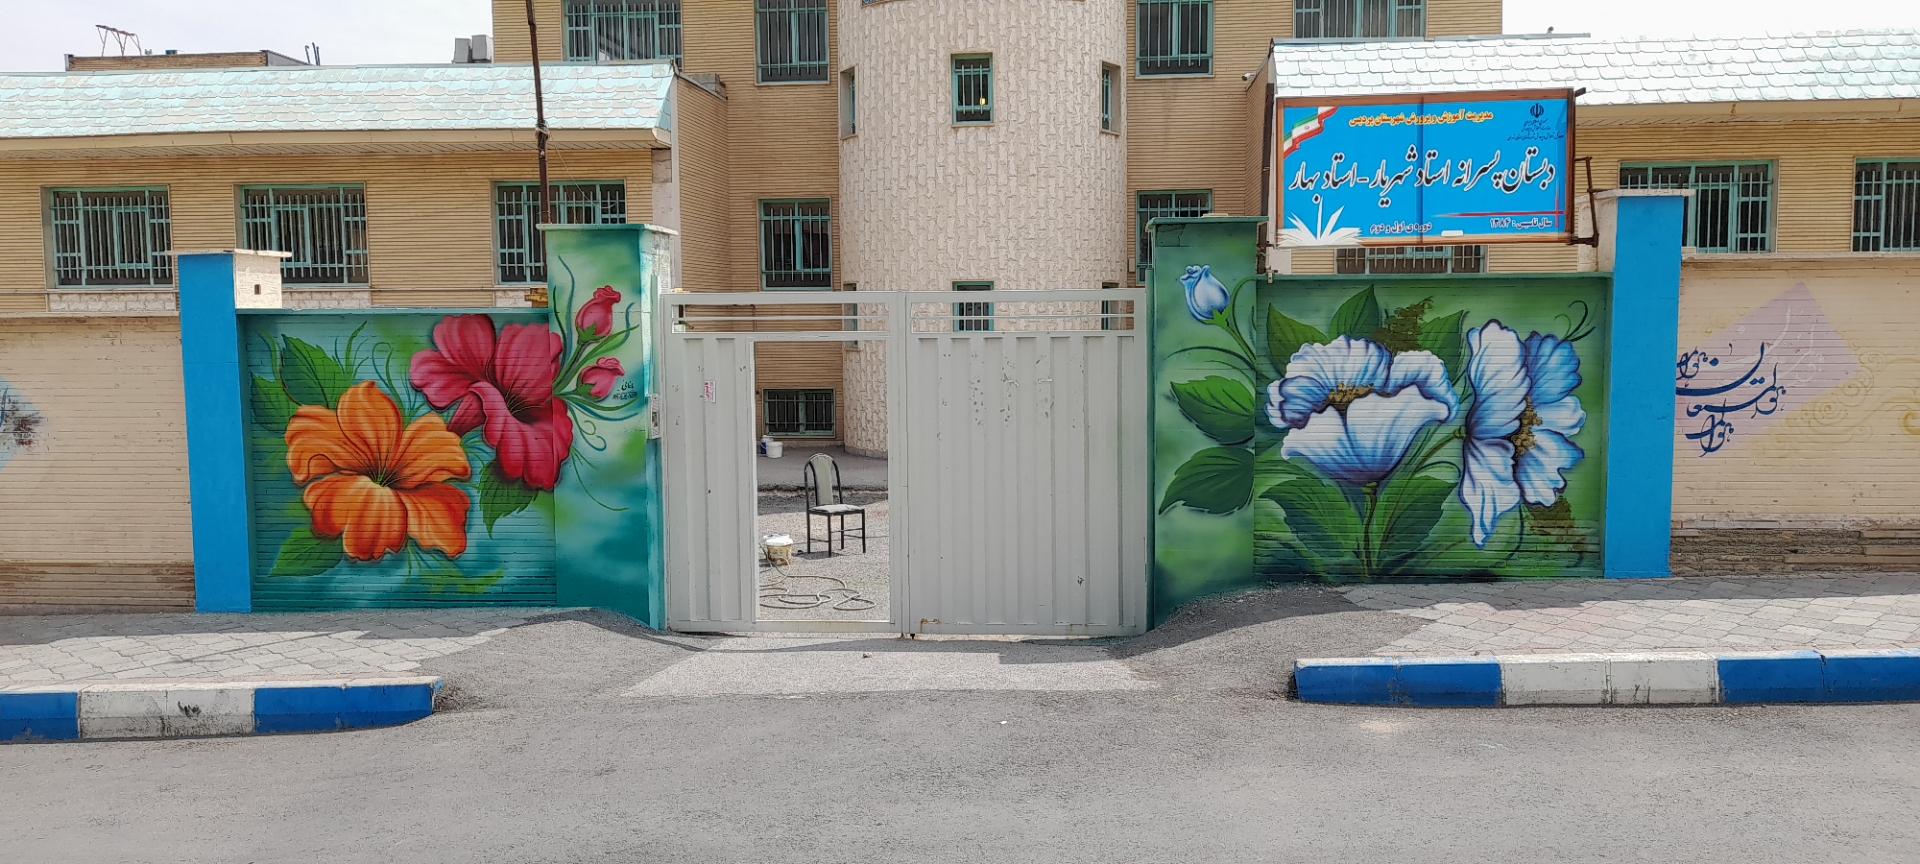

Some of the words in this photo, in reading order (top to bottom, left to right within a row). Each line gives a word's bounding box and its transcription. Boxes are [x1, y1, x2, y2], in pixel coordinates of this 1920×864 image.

[1349, 116, 1374, 127] پردیس
[1375, 113, 1405, 126] شهرستان
[1406, 112, 1432, 125] پرورش
[1438, 109, 1465, 123] آموزش
[1465, 111, 1494, 122] مدیریت
[1321, 152, 1358, 189] استاد
[1414, 149, 1451, 187] استاد
[1452, 150, 1501, 191] پسرانه
[1501, 146, 1555, 193] دبستان
[1288, 161, 1320, 204] بهار
[1369, 144, 1418, 208] شهریار
[1370, 223, 1385, 235] دوم
[1390, 220, 1405, 233] اول
[1538, 217, 1552, 229] سال
